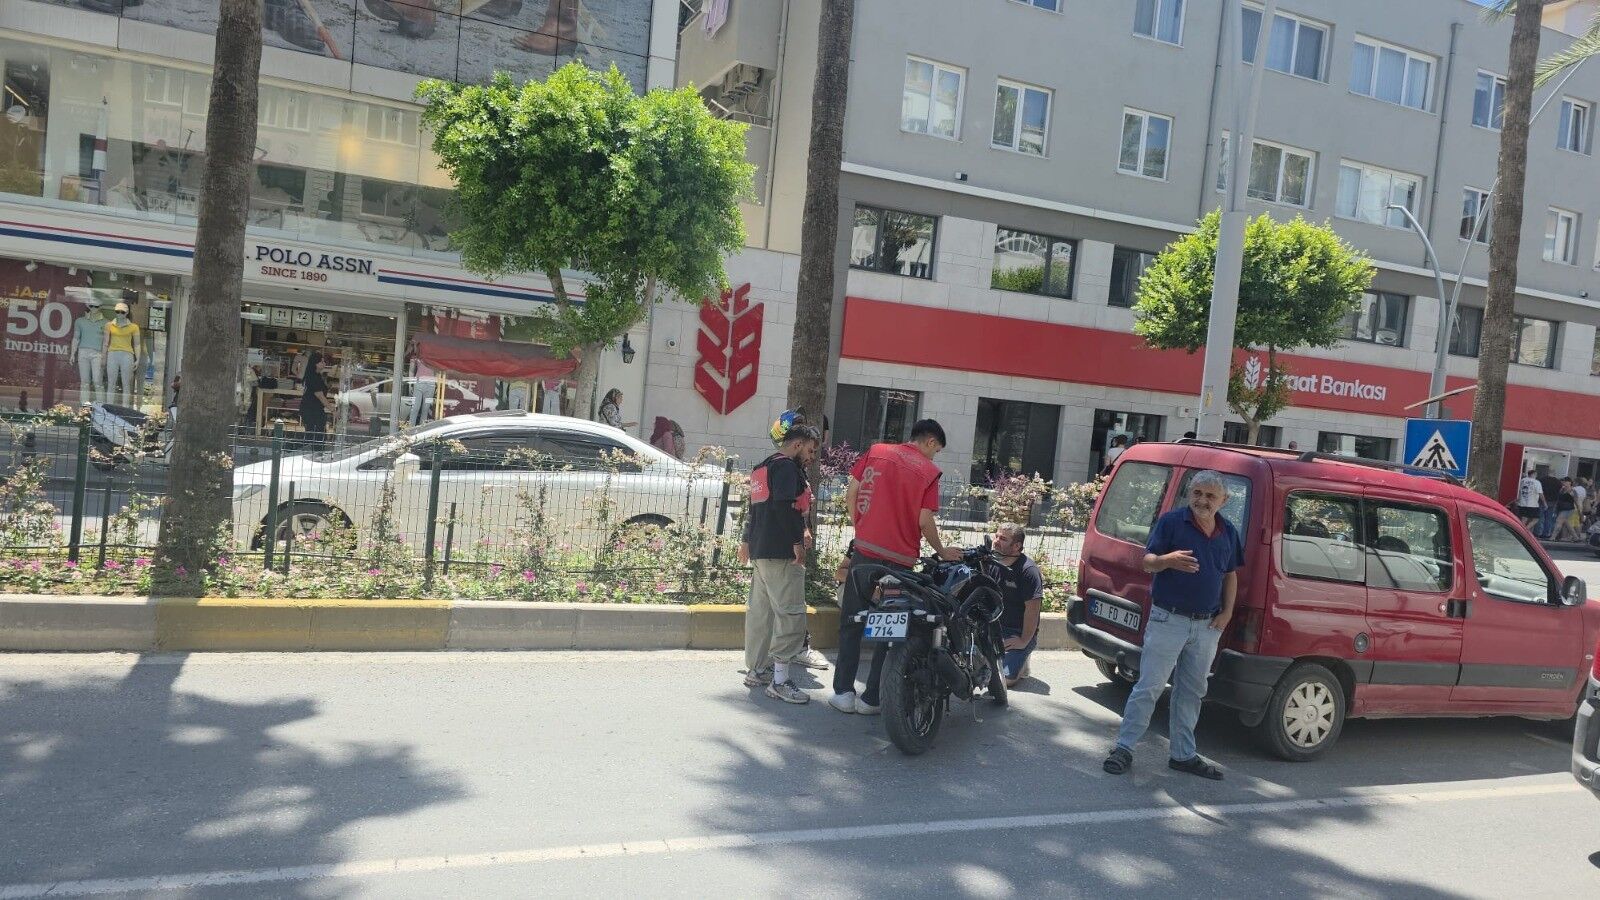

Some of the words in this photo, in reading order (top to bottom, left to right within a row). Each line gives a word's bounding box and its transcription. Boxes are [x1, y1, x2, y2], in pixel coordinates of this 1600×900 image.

[256, 246, 312, 267] POLO
[316, 254, 376, 275] ASSN.
[261, 266, 297, 278] SINCE
[301, 271, 327, 282] 1890
[5, 338, 69, 355] İNDİRİM
[1320, 375, 1387, 401] Bankası
[868, 615, 882, 625] 07
[885, 614, 907, 625] CJS
[875, 626, 893, 637] 714
